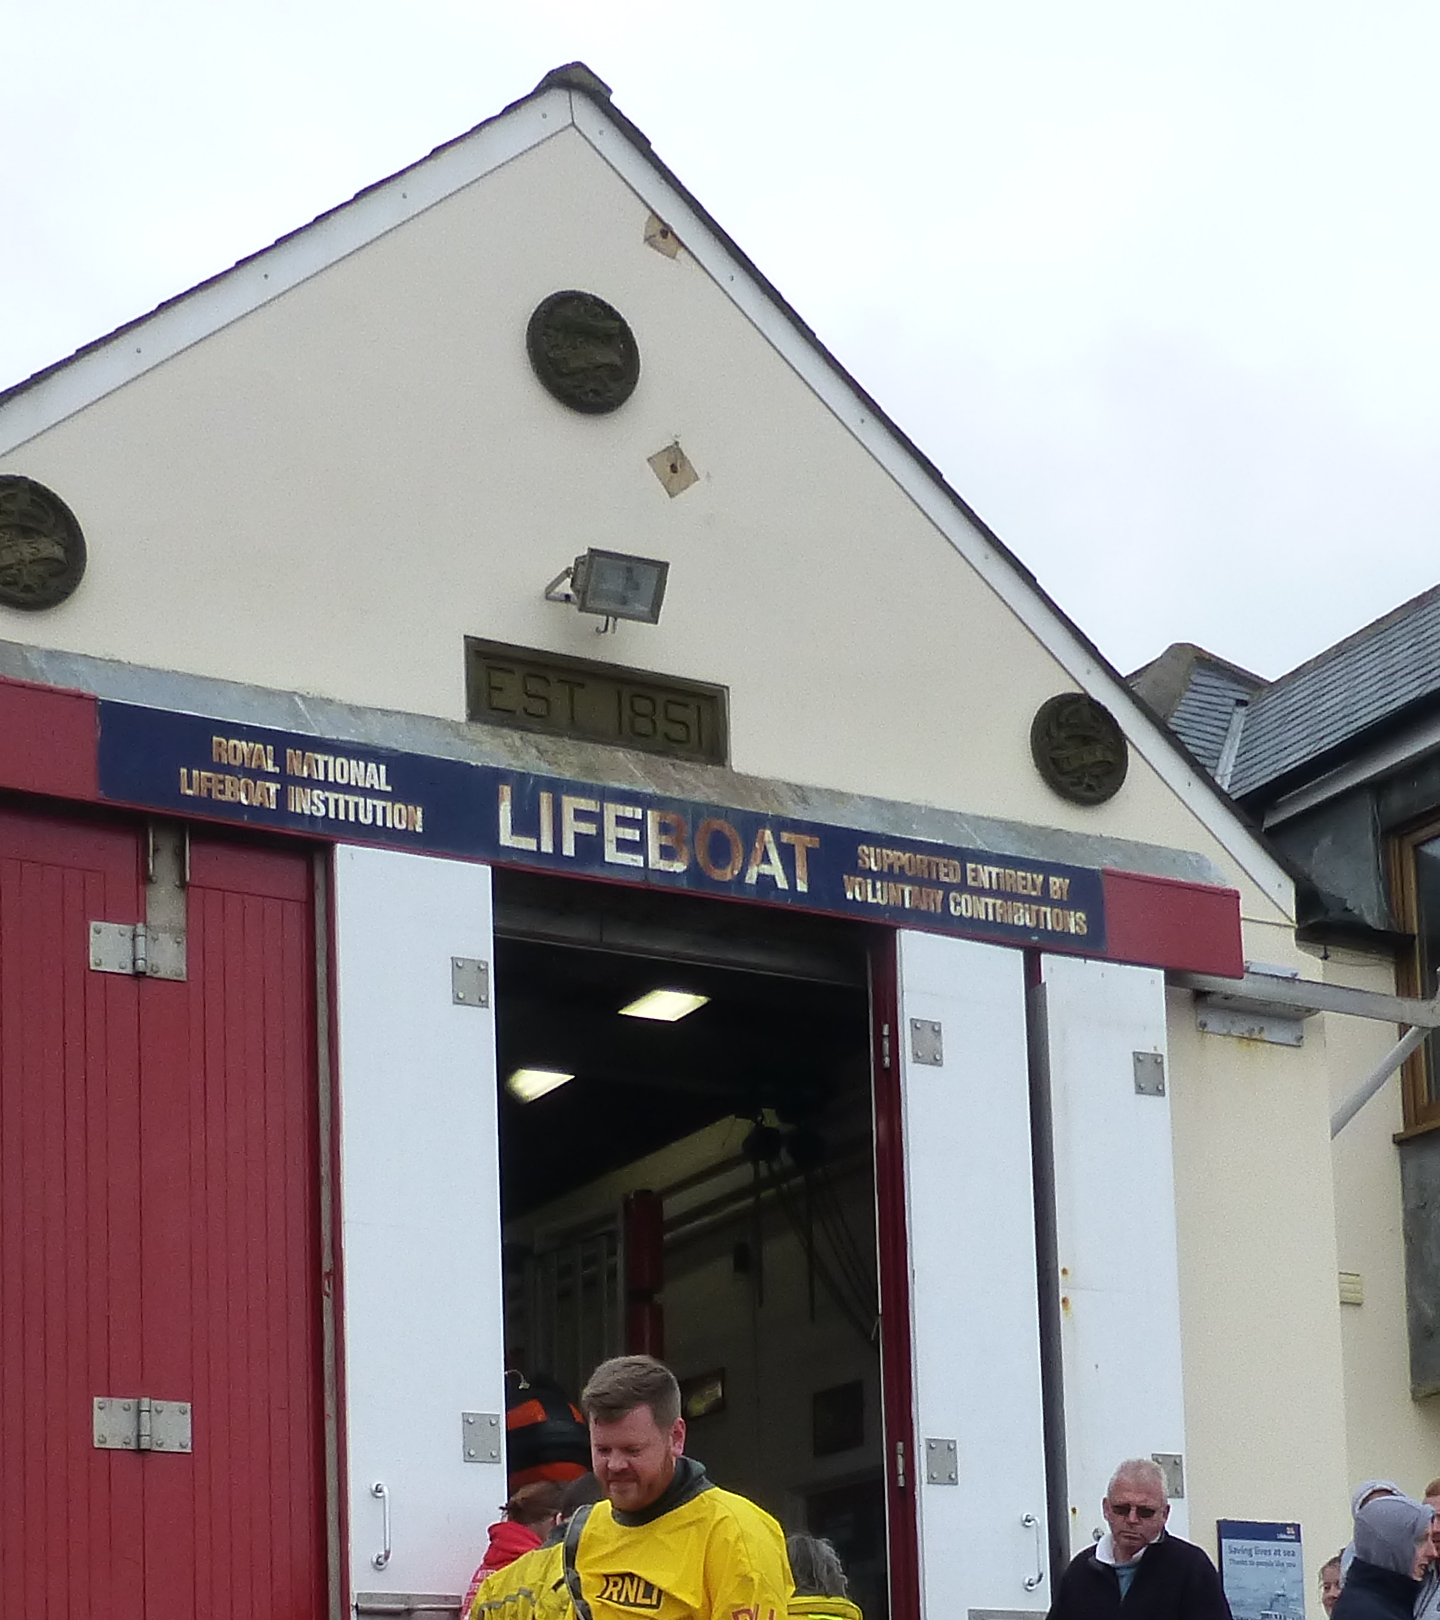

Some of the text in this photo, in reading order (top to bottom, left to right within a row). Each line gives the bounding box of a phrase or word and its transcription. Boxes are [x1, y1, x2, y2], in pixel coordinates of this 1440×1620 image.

[485, 665, 703, 748] EST 1851
[212, 735, 392, 793] ROYAL NATIONAL
[179, 767, 424, 834] LIFEBOAT INSTITUTION
[497, 784, 820, 893] LIFEBOAT
[857, 843, 1071, 902] SUPPORTED ENTIRELY BY
[842, 876, 1088, 937] VOLUNTARY CONTRIBUTIONS
[602, 1575, 658, 1606] RNLI
